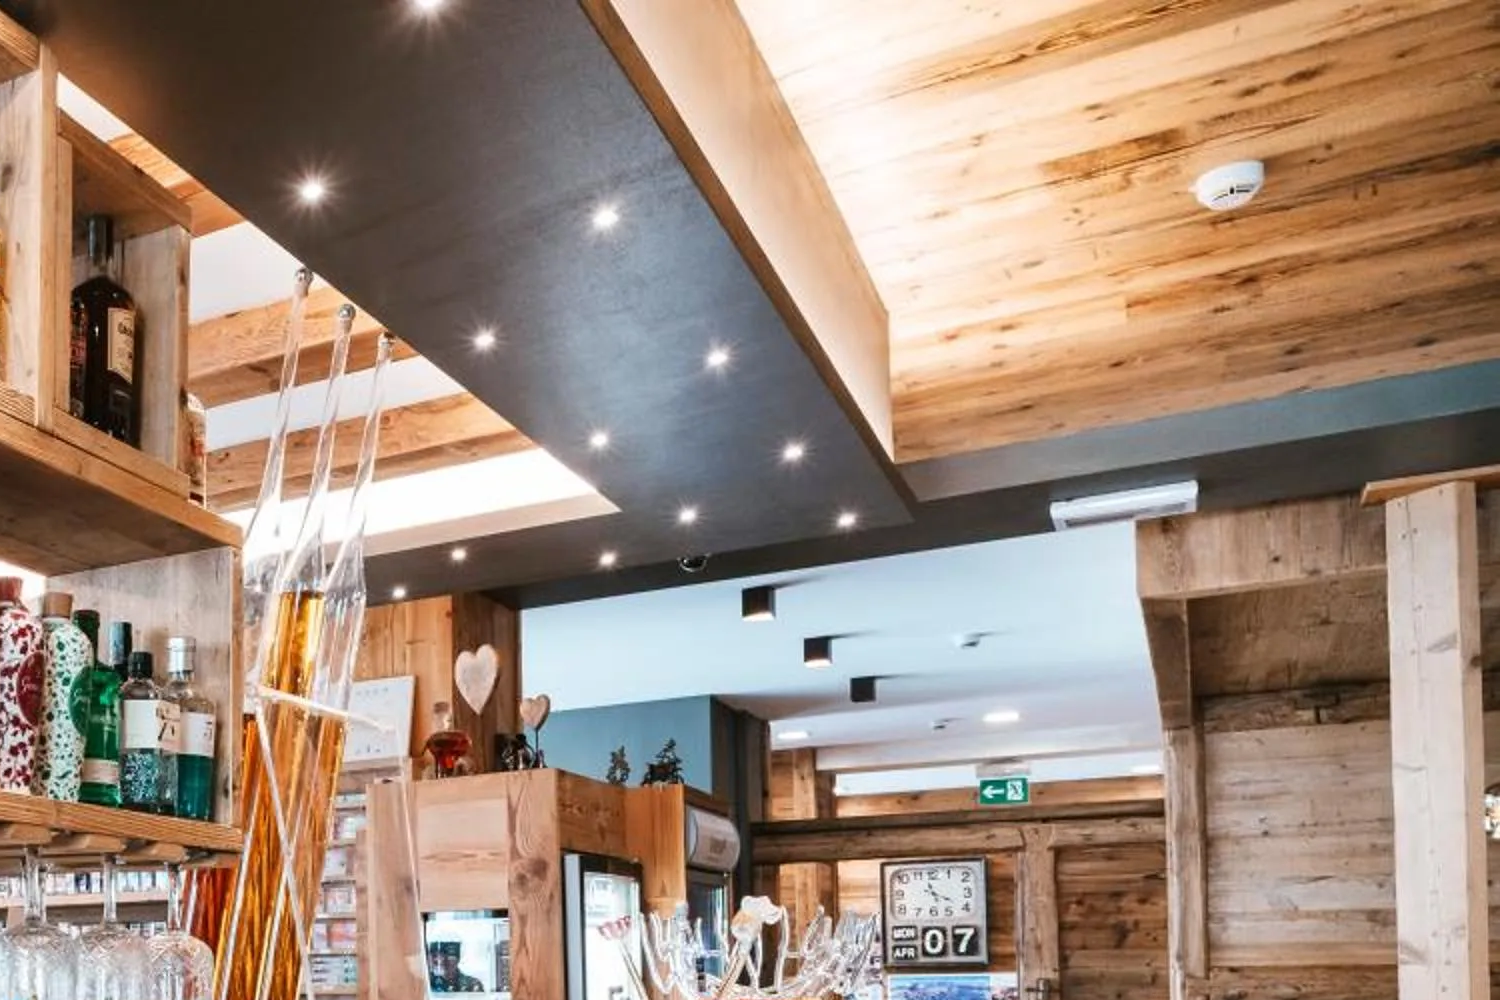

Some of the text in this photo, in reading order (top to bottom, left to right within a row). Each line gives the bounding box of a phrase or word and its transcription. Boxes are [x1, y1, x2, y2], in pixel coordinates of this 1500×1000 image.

[961, 871, 971, 883] 2
[963, 887, 973, 899] 3
[929, 906, 939, 917] 6
[944, 906, 954, 917] 5
[961, 901, 971, 913] 4
[893, 947, 916, 959] APR
